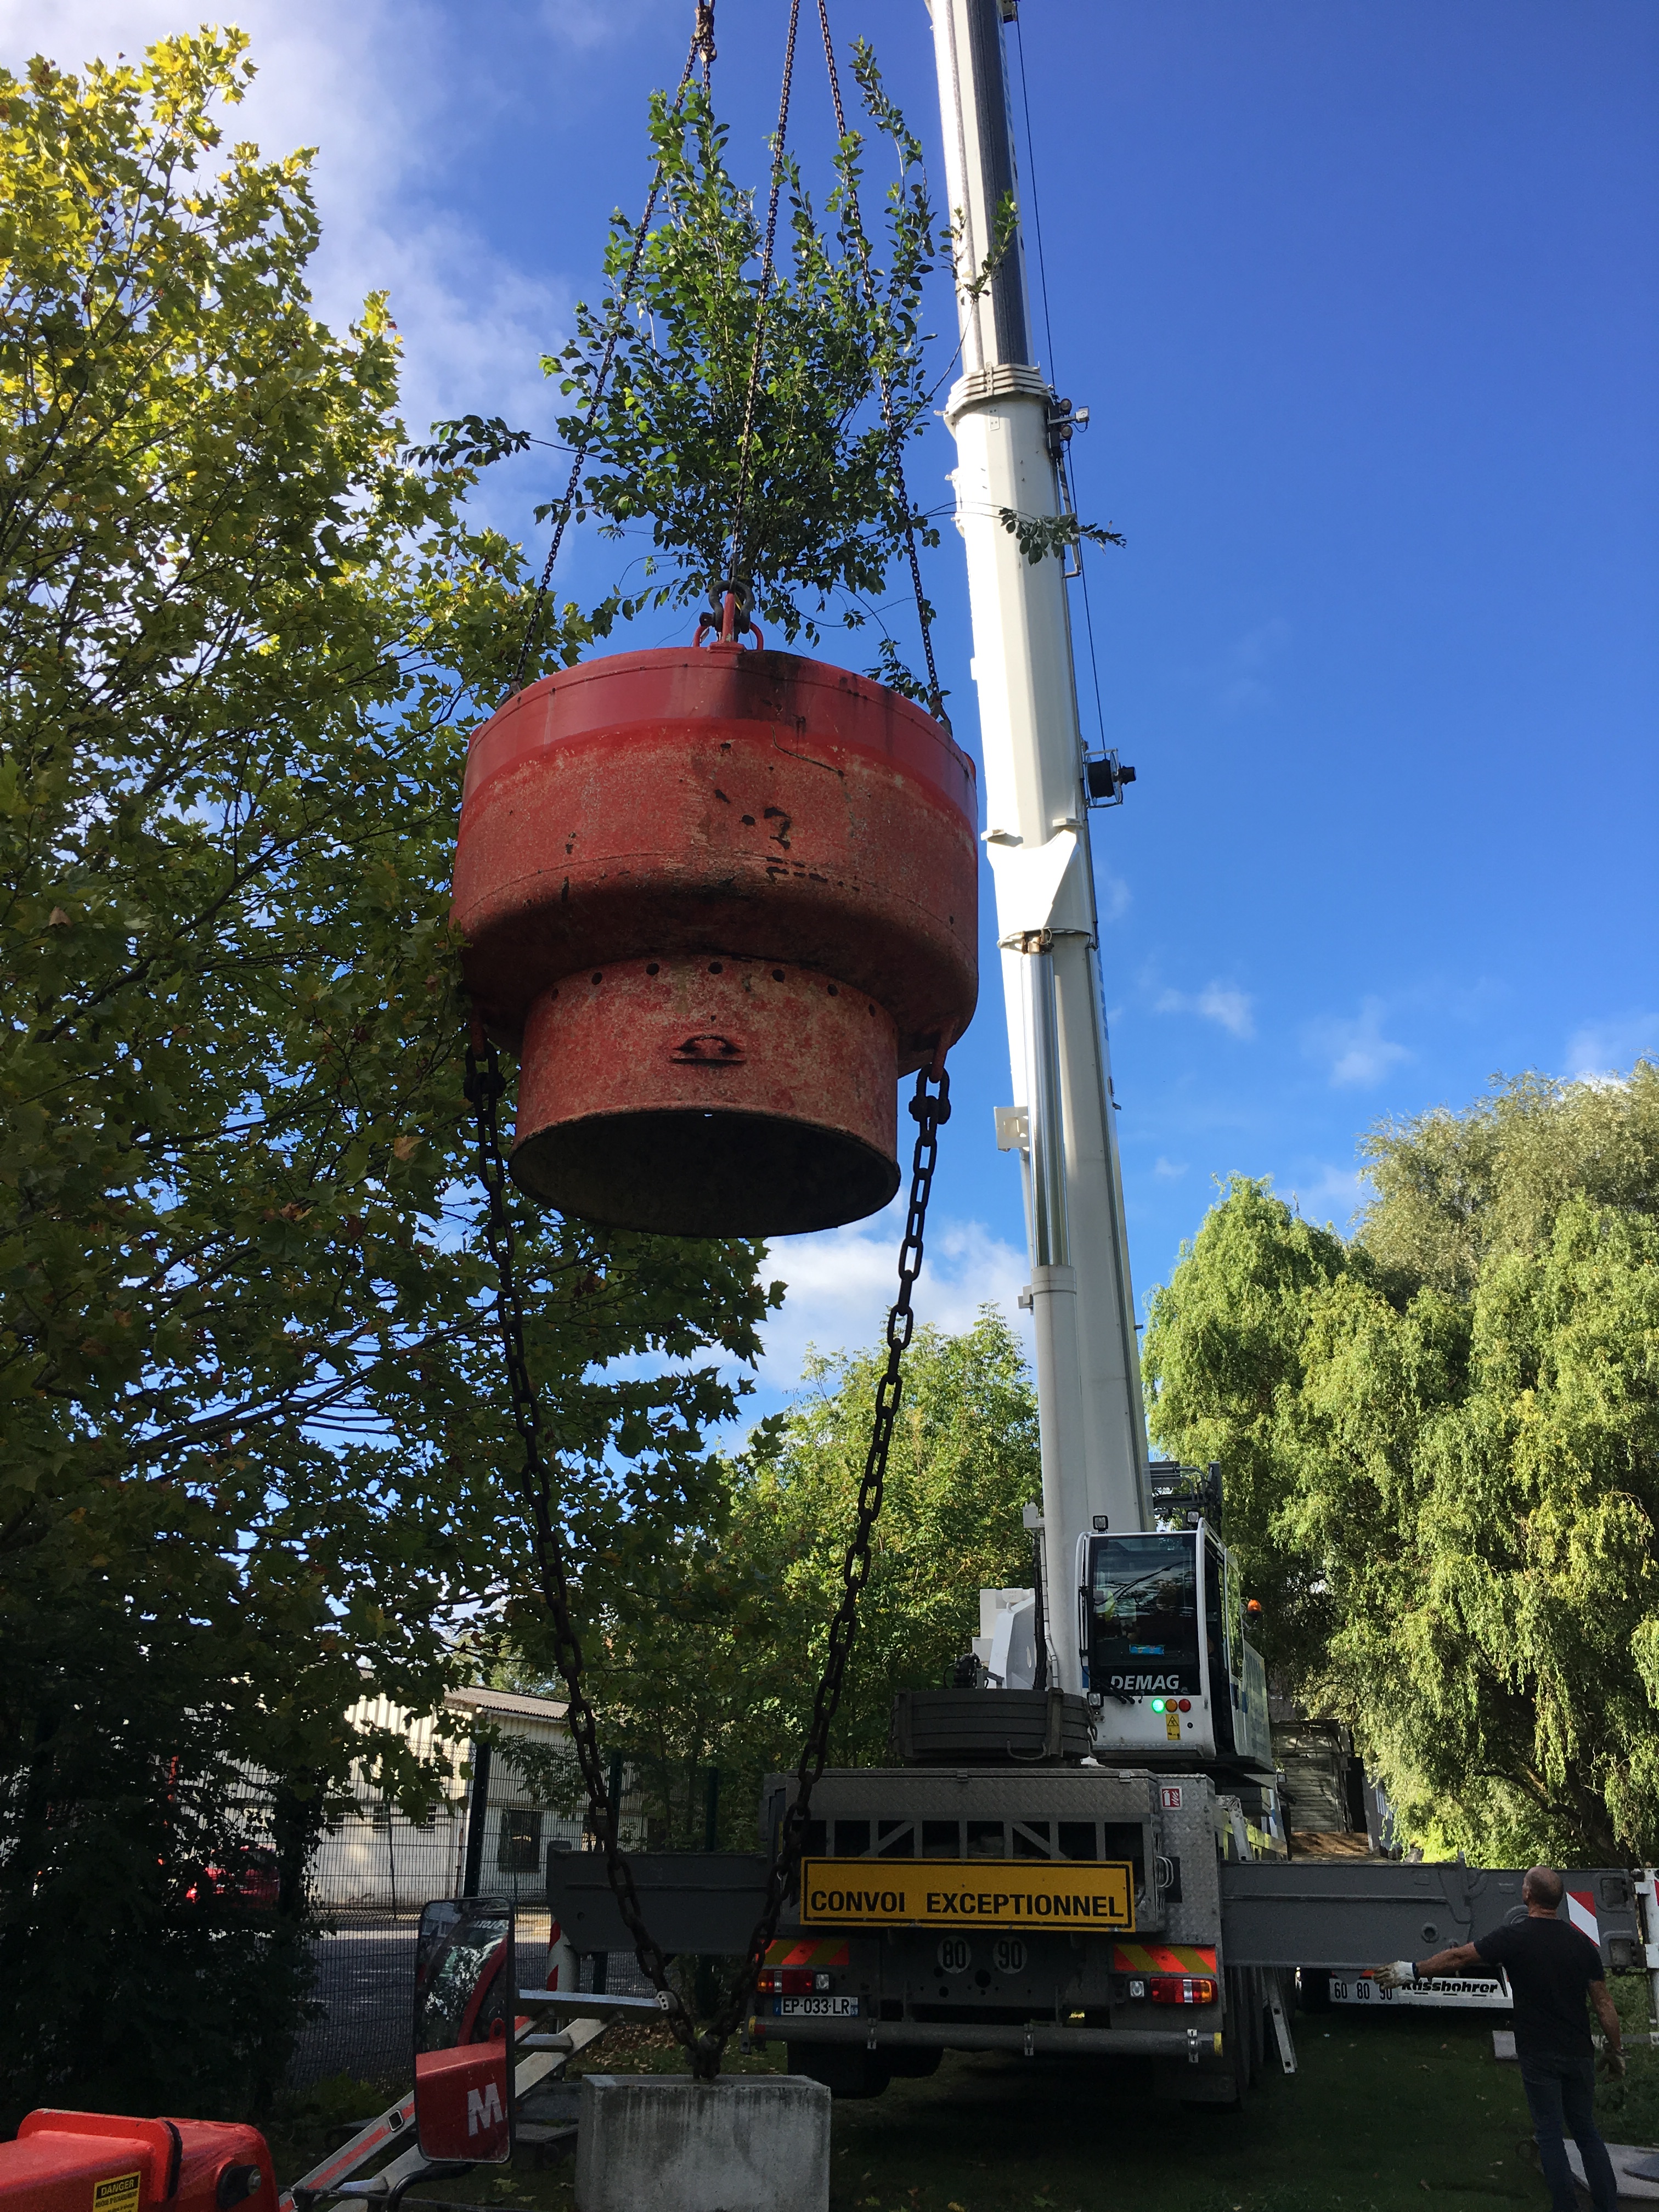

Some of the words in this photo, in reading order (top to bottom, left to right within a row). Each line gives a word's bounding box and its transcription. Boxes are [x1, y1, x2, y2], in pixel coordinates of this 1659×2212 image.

[1110, 1674, 1180, 1690] DEMAG
[810, 1891, 905, 1912] CONVOI
[926, 1892, 1124, 1917] EXCEPTIONNEL
[943, 1940, 966, 1968] 80
[998, 1940, 1022, 1969] 90
[1334, 1982, 1347, 1999] 60
[1356, 1982, 1370, 2000] 80
[101, 2179, 134, 2196] DANGER
